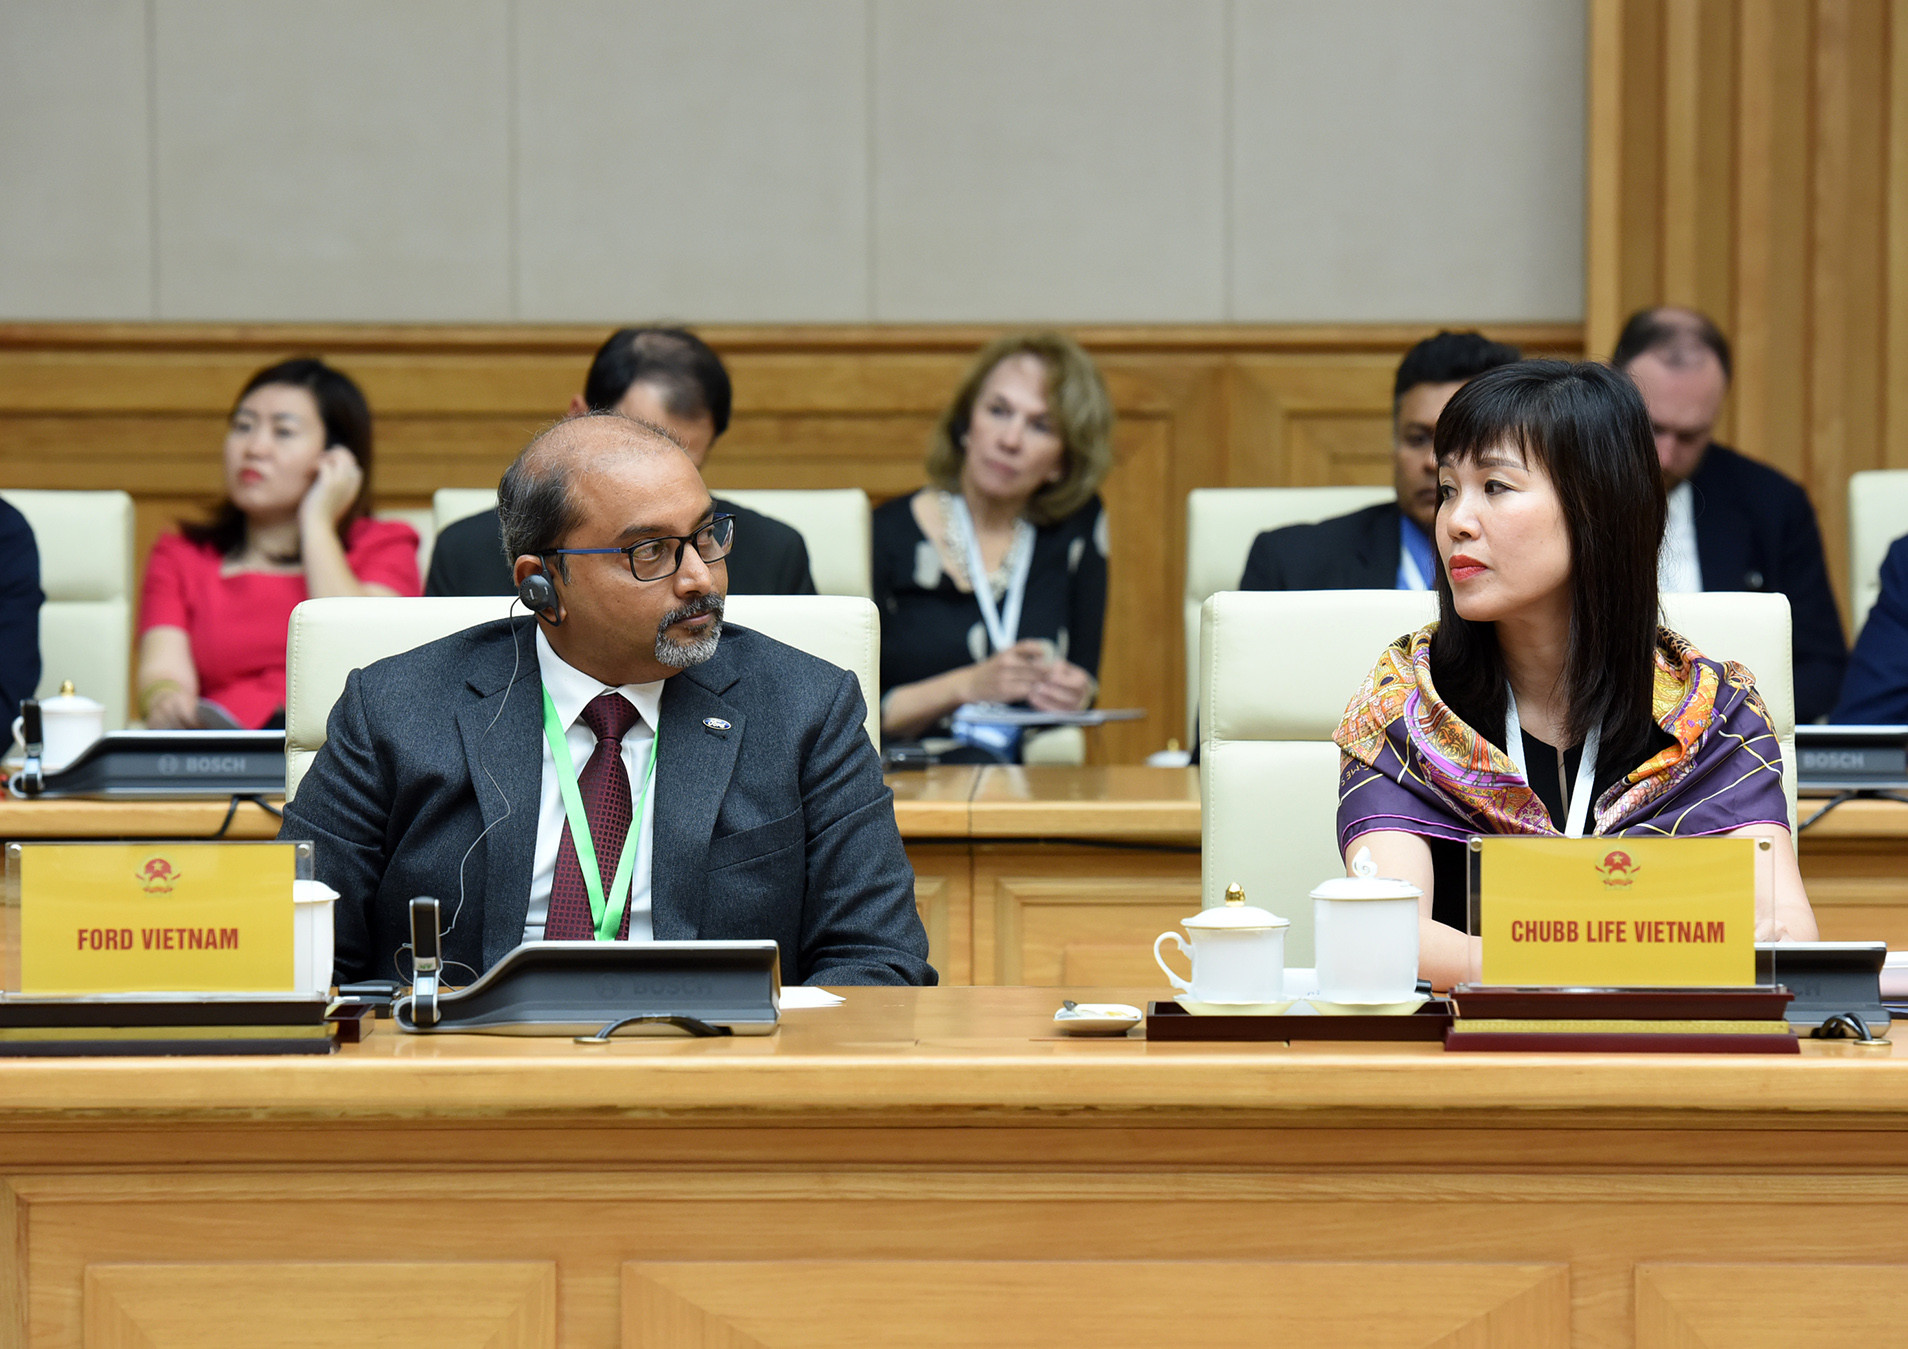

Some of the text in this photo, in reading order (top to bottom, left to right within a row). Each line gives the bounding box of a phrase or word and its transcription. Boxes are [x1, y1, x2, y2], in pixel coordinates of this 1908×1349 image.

[185, 757, 246, 773] BOSCH
[1803, 751, 1864, 769] BOSCH
[77, 928, 239, 951] FORD VIETNAM
[1511, 920, 1726, 943] CHUBB LIFE VIETNAM
